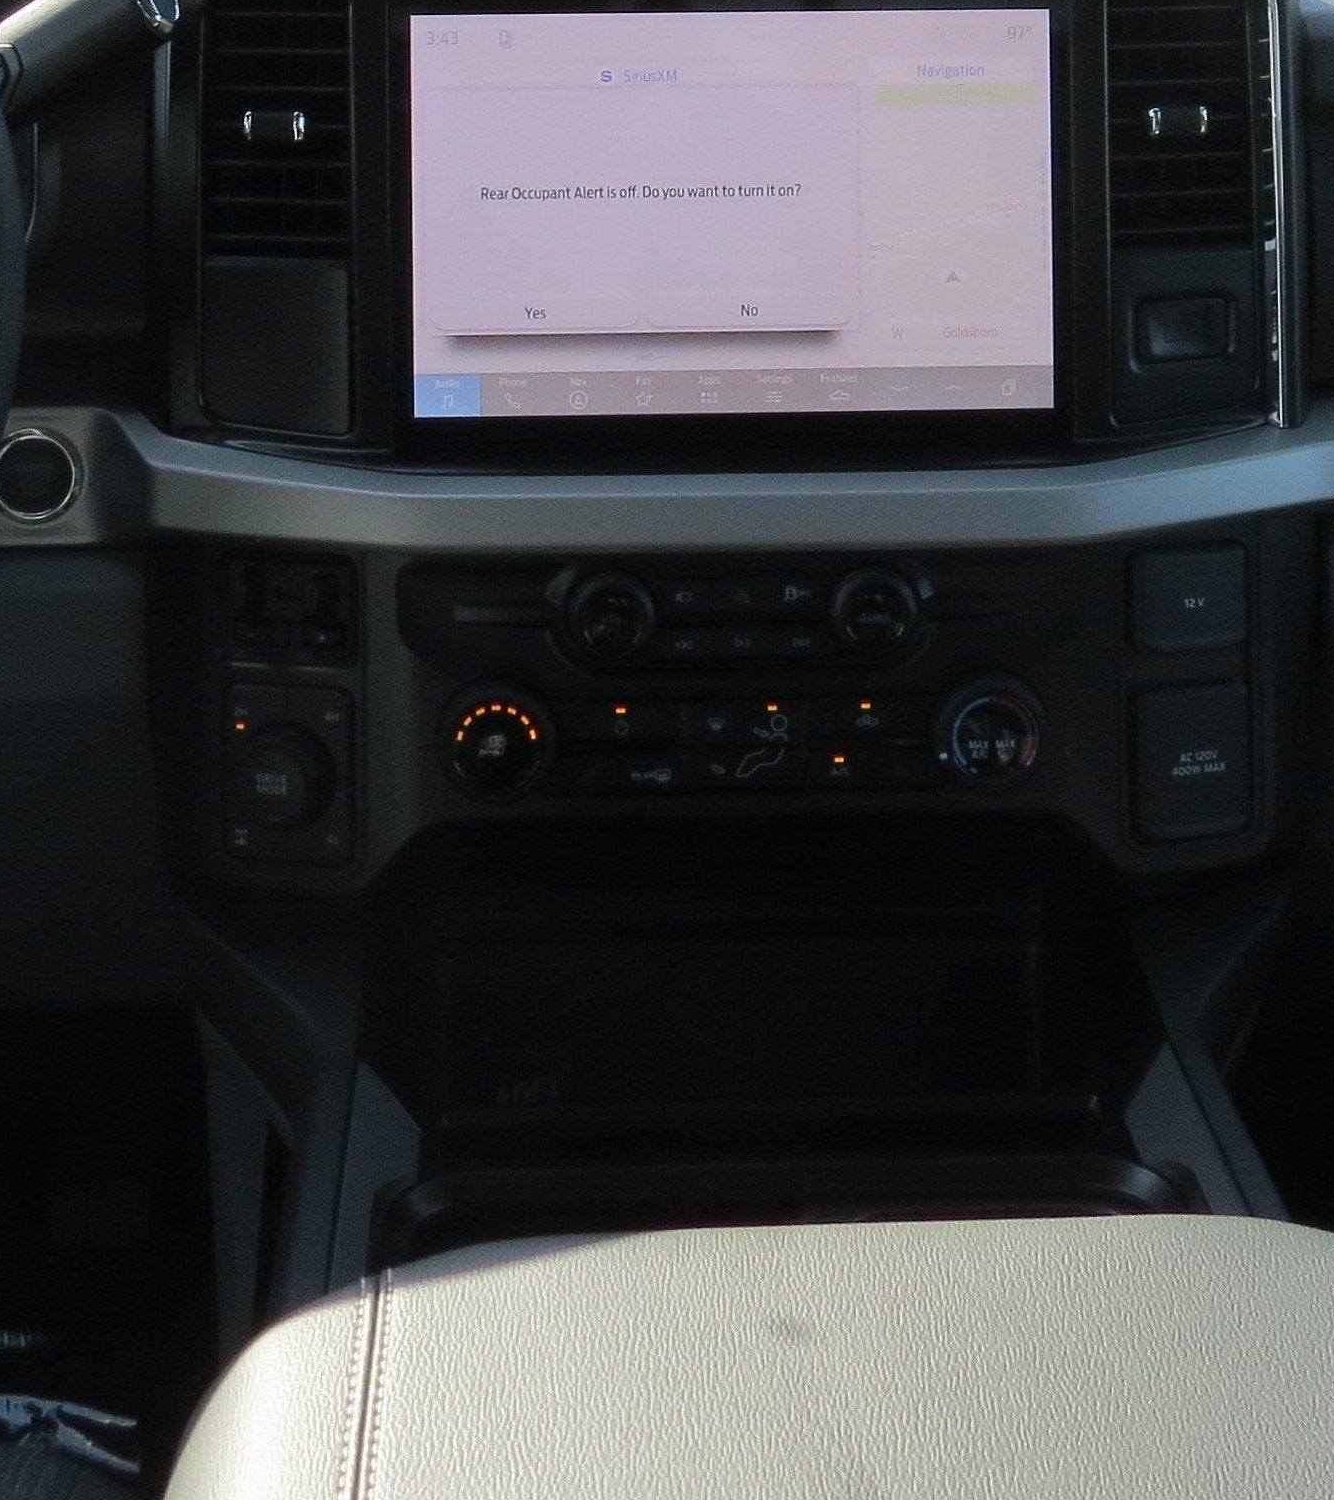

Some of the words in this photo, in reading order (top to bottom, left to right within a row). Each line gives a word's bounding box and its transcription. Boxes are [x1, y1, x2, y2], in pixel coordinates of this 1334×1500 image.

[427, 31, 458, 46] 3:43
[623, 69, 678, 83] SiriusXM
[916, 64, 985, 80] Navigation
[480, 187, 509, 200] Rear
[511, 186, 570, 202] Occupant
[574, 186, 604, 200] Alert
[607, 186, 617, 199] is
[619, 185, 640, 199] off.
[642, 185, 659, 199] Do
[662, 187, 685, 201] you
[687, 185, 719, 198] want
[722, 185, 736, 198] to
[738, 185, 764, 198] turn
[766, 184, 776, 197] it
[778, 184, 802, 198] on?
[524, 306, 547, 320] Yes
[740, 303, 759, 317] No
[892, 327, 904, 339] W
[943, 326, 999, 340] Goldsboro
[499, 376, 528, 389] Phone
[569, 375, 588, 388] Nav
[697, 374, 721, 388] Apps
[756, 373, 793, 386] Settings
[820, 372, 859, 385] Features
[1204, 761, 1226, 774] MAX
[256, 784, 288, 796] MODE
